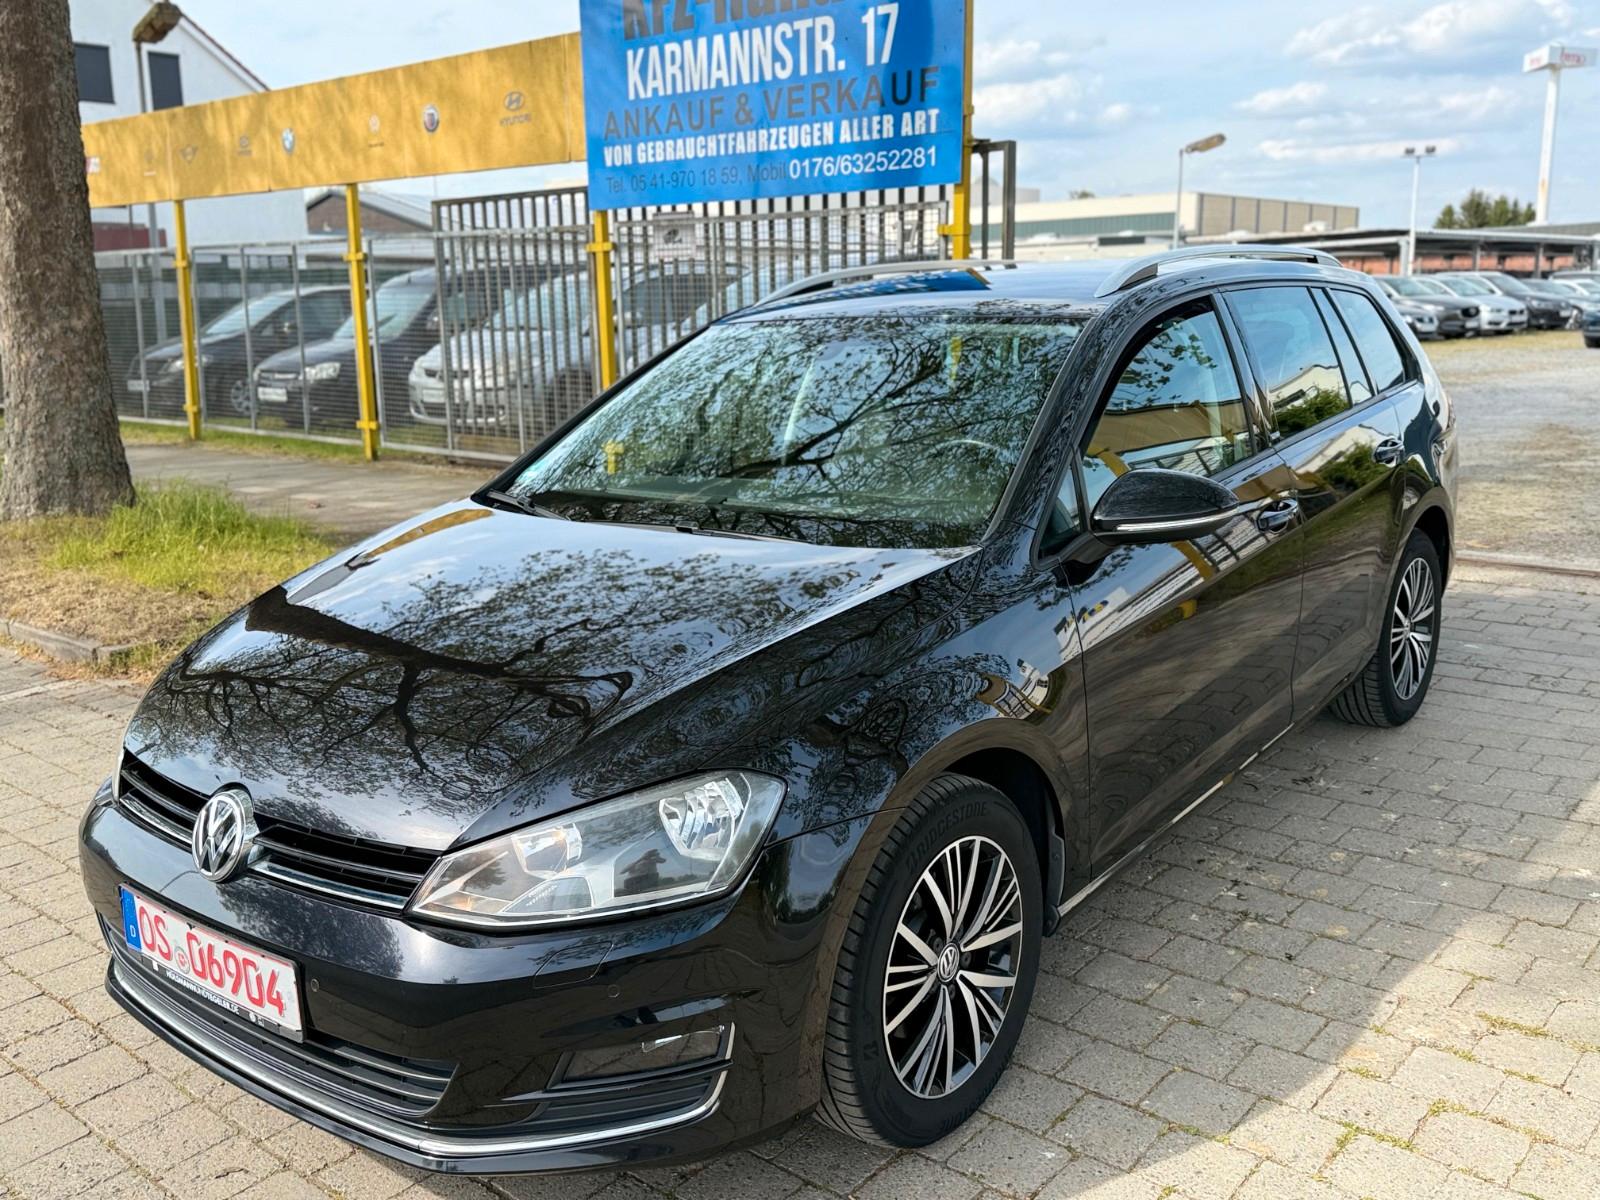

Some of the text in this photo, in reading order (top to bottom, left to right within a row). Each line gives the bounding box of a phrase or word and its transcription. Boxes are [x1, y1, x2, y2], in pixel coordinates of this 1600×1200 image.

[626, 15, 846, 100] KARMANNSTR.
[861, 2, 899, 67] 17
[604, 66, 940, 141] ANKAUF & VERKAUF
[604, 108, 940, 167] VON GEBRAUCHTFAHRZEUGEN ALLER ART
[788, 145, 936, 179] 0176/63252281
[130, 924, 137, 938] D
[139, 906, 173, 962] OS
[186, 931, 286, 1018] 06904
